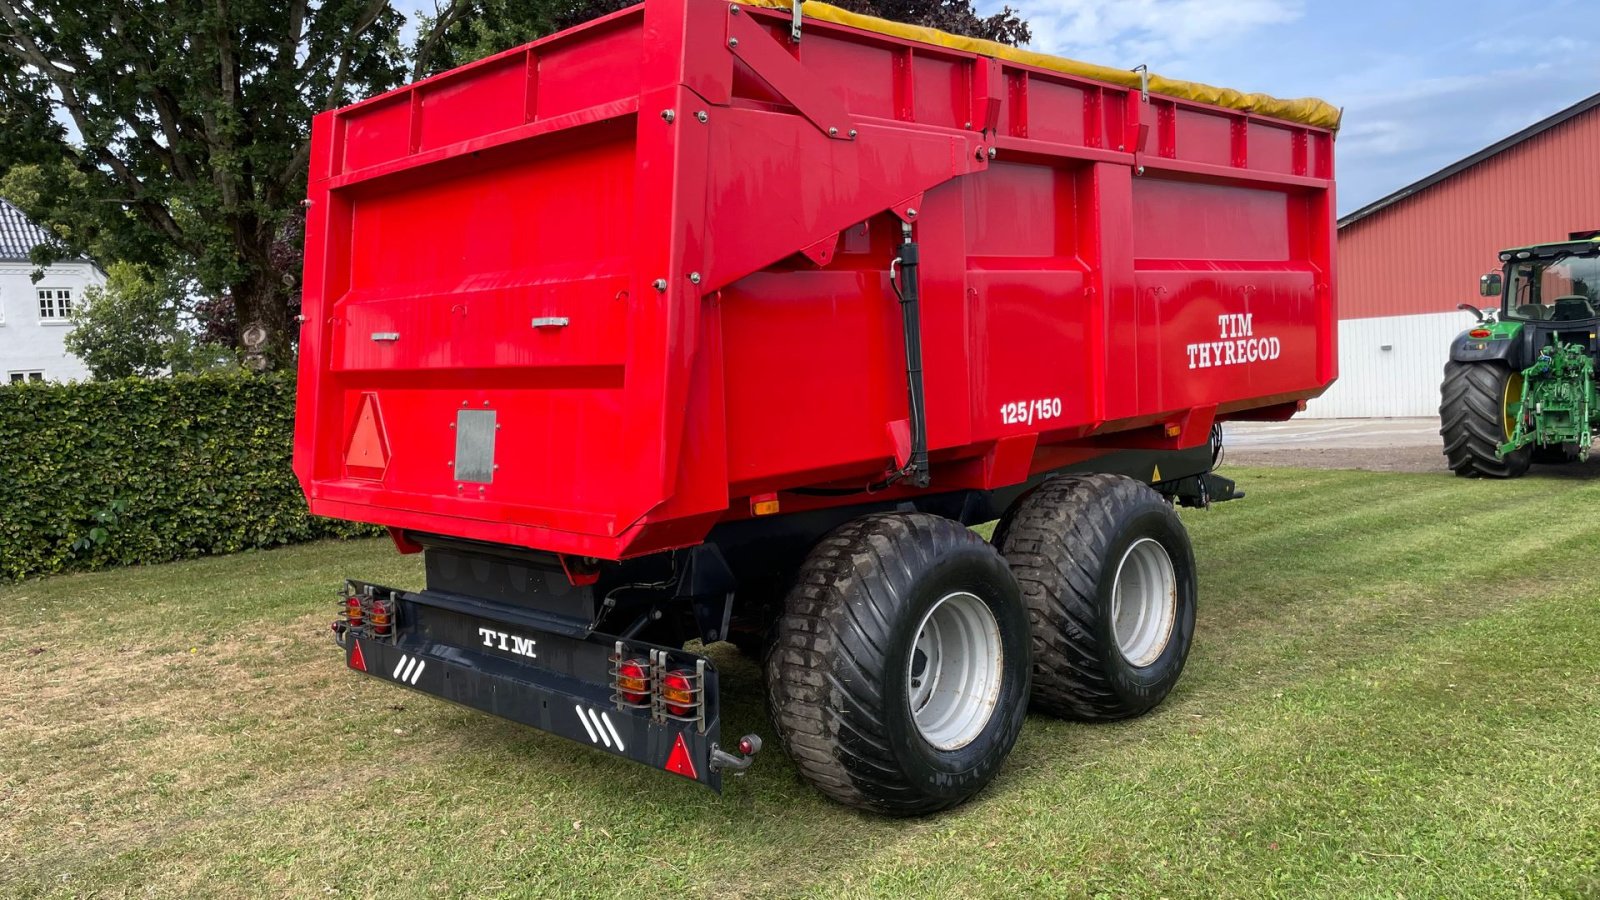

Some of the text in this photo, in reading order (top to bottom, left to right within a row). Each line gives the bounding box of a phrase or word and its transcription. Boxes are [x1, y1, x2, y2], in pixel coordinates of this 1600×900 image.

[1218, 313, 1253, 338] TIM
[1187, 337, 1280, 369] THYREGOD
[1000, 398, 1062, 425] 125/150
[478, 628, 537, 658] TIM
